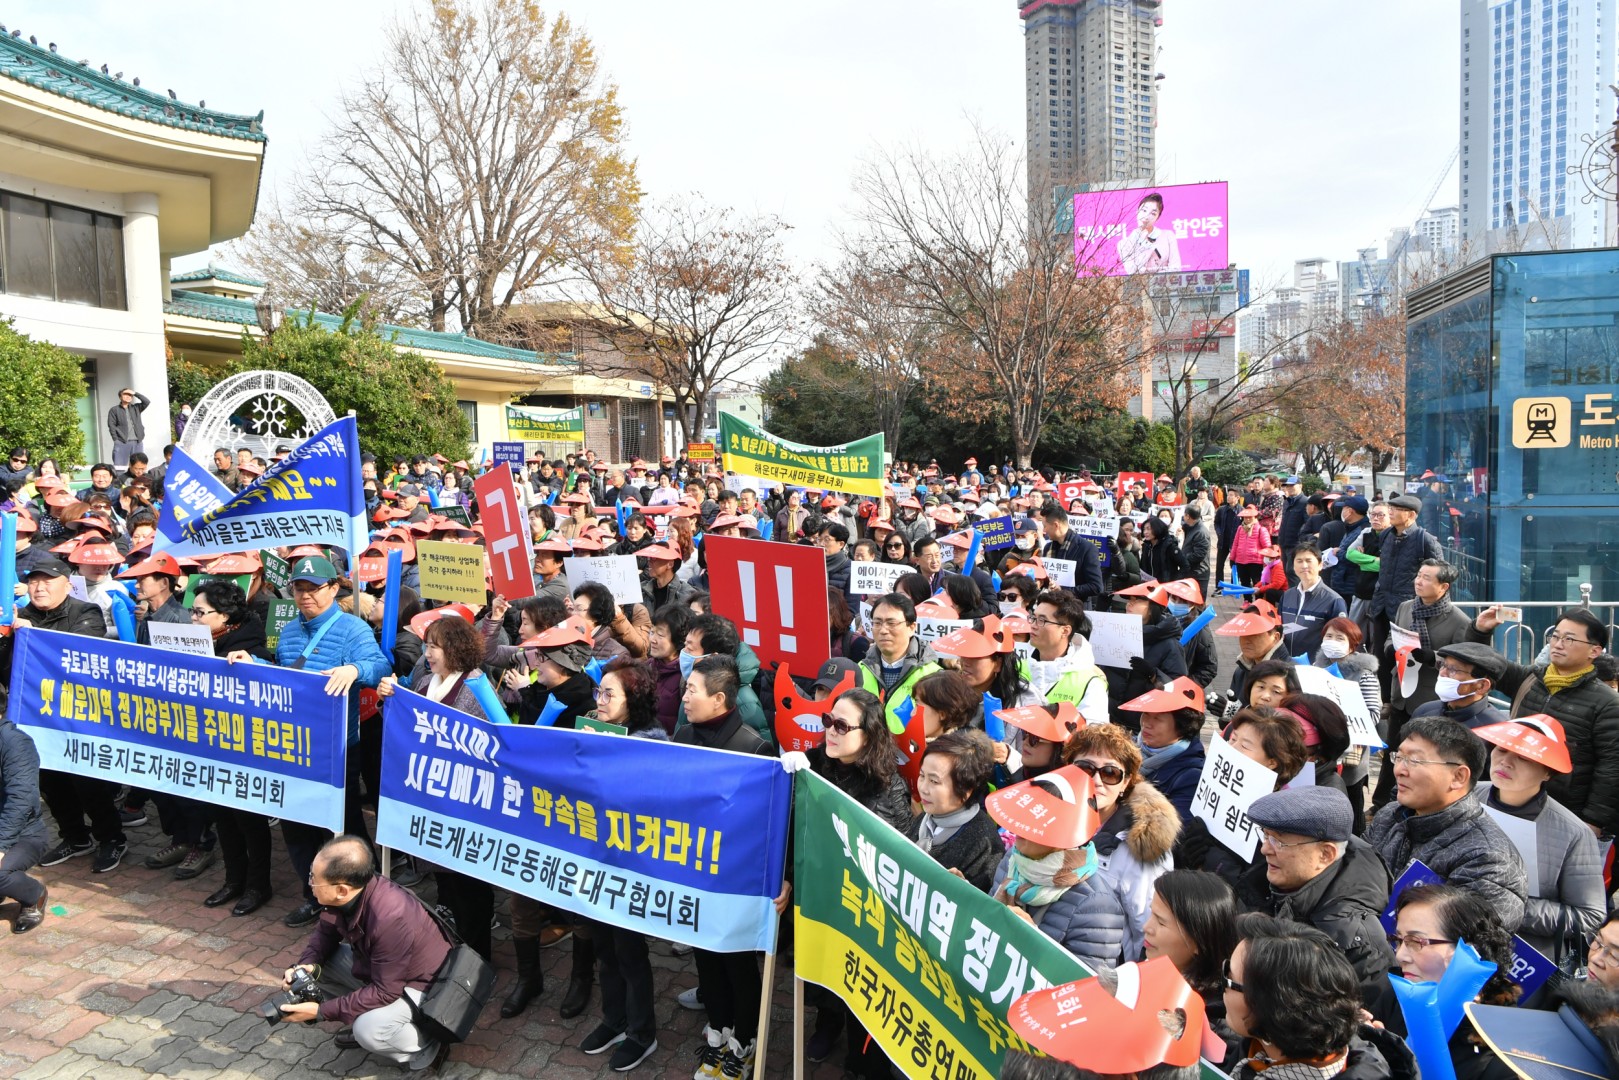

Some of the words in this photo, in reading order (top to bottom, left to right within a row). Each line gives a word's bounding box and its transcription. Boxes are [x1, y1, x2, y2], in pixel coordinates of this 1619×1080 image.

[1172, 217, 1223, 239] 할인중
[1580, 394, 1619, 425] 도
[741, 435, 776, 458] 해운대역
[830, 455, 869, 473] 철회하라
[1580, 434, 1612, 449] Metro
[754, 462, 844, 488] 해운대구새마을부녀회
[191, 514, 346, 548] 새마을문고해운대구지부
[485, 488, 519, 581] 구
[1069, 519, 1113, 530] 에이지스위트
[359, 562, 383, 571] 원화!
[441, 567, 462, 576] 중지하라
[857, 579, 883, 590] 입주민
[737, 560, 797, 653] !!
[61, 648, 115, 682] 국토교통부,
[115, 658, 210, 700] 한국철도시설공단에
[212, 676, 246, 705] 보내는
[249, 680, 293, 714] 메시지!!
[40, 678, 55, 716] 옛
[59, 679, 114, 726] 해운대역
[118, 691, 199, 744] 정거장부지를
[203, 710, 245, 753] 주민의
[251, 716, 311, 768] 품으로!!
[63, 738, 285, 808] 새마을지도자해운대구협의회
[1212, 752, 1245, 797] 공원은
[404, 752, 495, 811] 시민에게
[501, 775, 525, 819] 한
[532, 785, 598, 842] 약속을
[605, 808, 722, 875] 지켜라!!
[1003, 788, 1056, 828] 공원화!
[1225, 804, 1254, 842] 쉼터
[410, 814, 700, 932] 바르게살기운동해운대구협의회
[856, 833, 958, 960] 해운대역
[841, 868, 886, 948] 녹색
[891, 914, 966, 1024] 공원화
[1051, 983, 1088, 1029] 원화!
